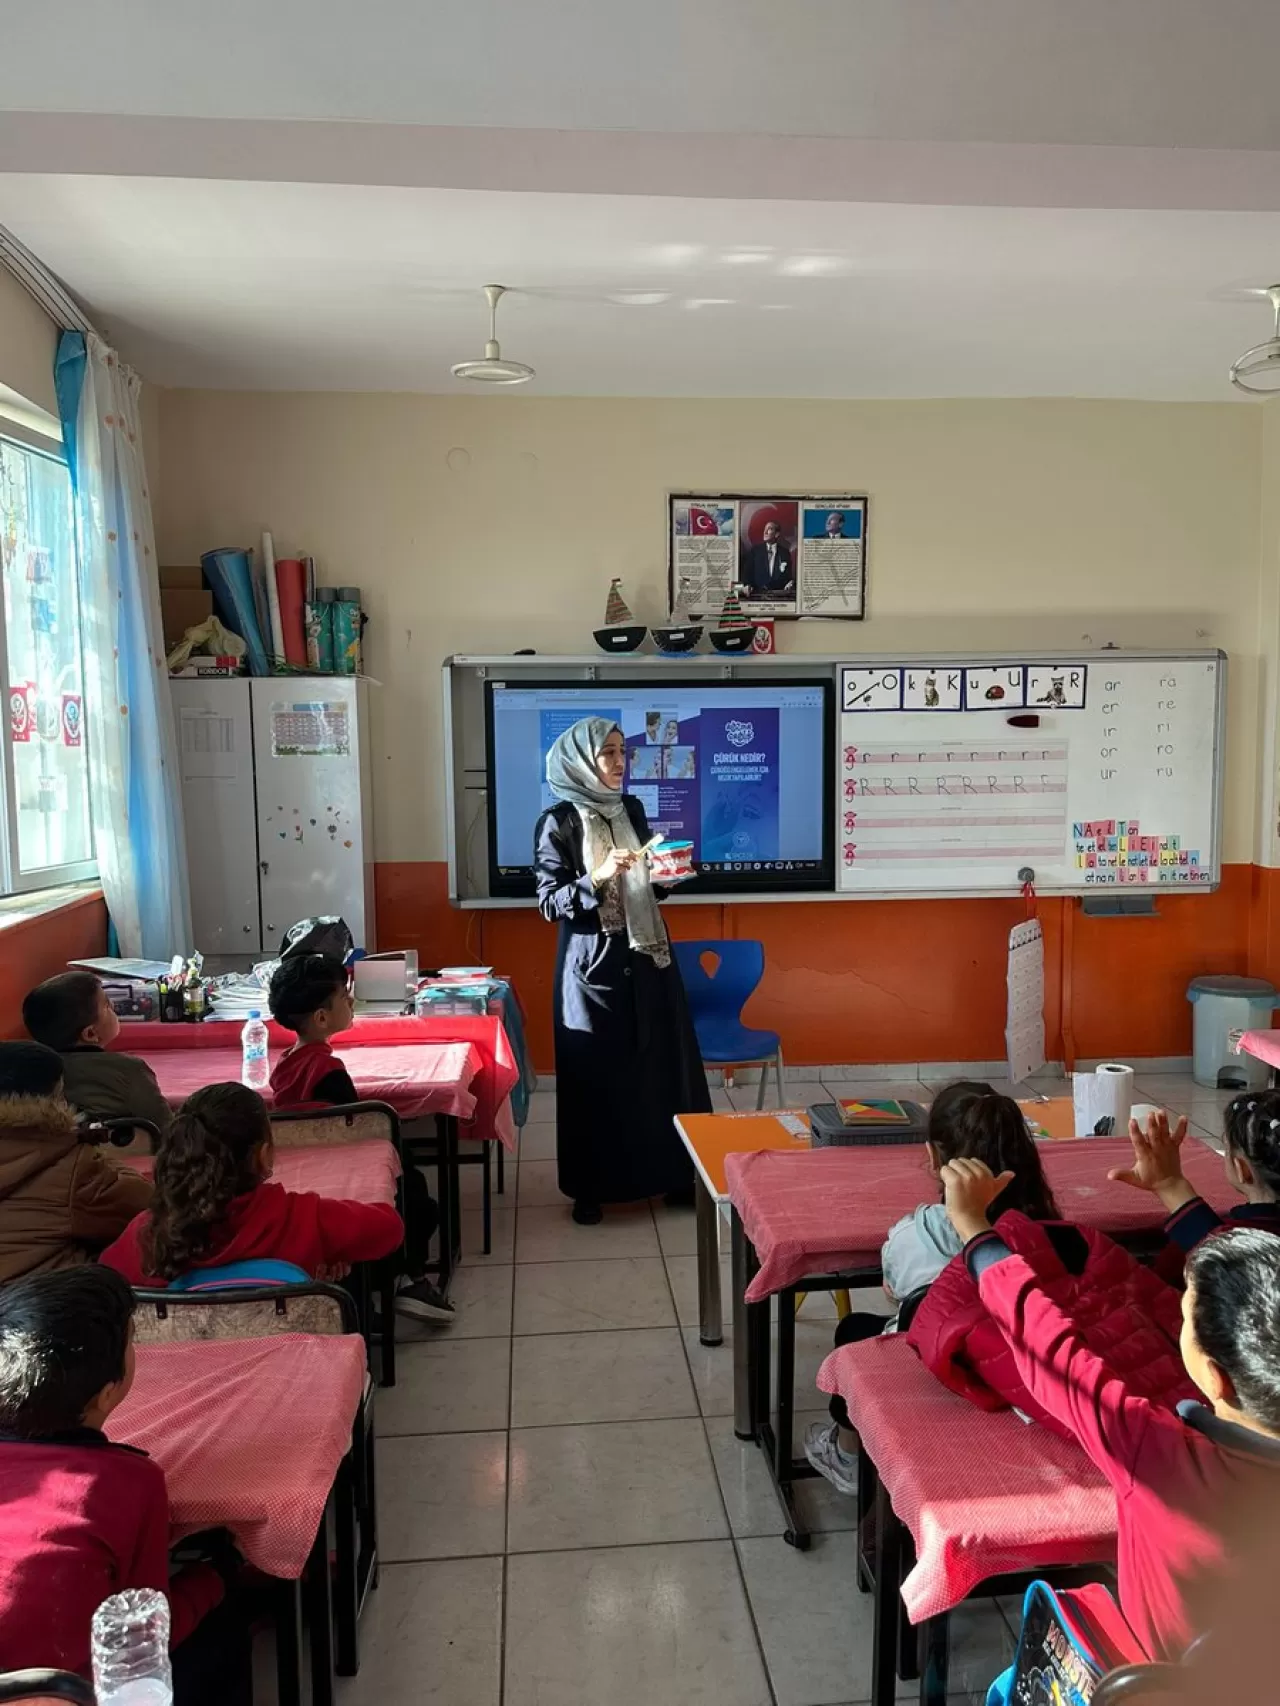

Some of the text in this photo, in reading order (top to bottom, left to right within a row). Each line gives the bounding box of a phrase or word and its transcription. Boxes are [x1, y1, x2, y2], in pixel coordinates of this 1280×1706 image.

[847, 673, 898, 691] o O
[908, 674, 959, 691] k K
[970, 671, 1021, 689] u U
[1031, 671, 1080, 688] r R
[1159, 677, 1177, 688] ra
[1104, 680, 1121, 692] ar
[1101, 702, 1119, 715] er
[1158, 699, 1176, 710] re
[1100, 747, 1118, 758] or
[1157, 744, 1174, 755] ro
[713, 751, 766, 765] ÇÜRÜK NEDİR?
[863, 752, 871, 763] r
[891, 752, 900, 763] r
[919, 752, 927, 762] r
[946, 751, 955, 762] r
[970, 751, 979, 762] r
[998, 751, 1007, 761] r
[1022, 751, 1031, 761] r
[1100, 768, 1118, 780] ur
[1156, 767, 1173, 777] ru
[859, 777, 876, 796] R
[883, 777, 898, 796] R
[908, 777, 923, 795] R
[936, 776, 952, 795] R
[962, 775, 978, 795] R
[988, 775, 1003, 794] R
[1013, 775, 1028, 794] R
[1084, 823, 1093, 837] A
